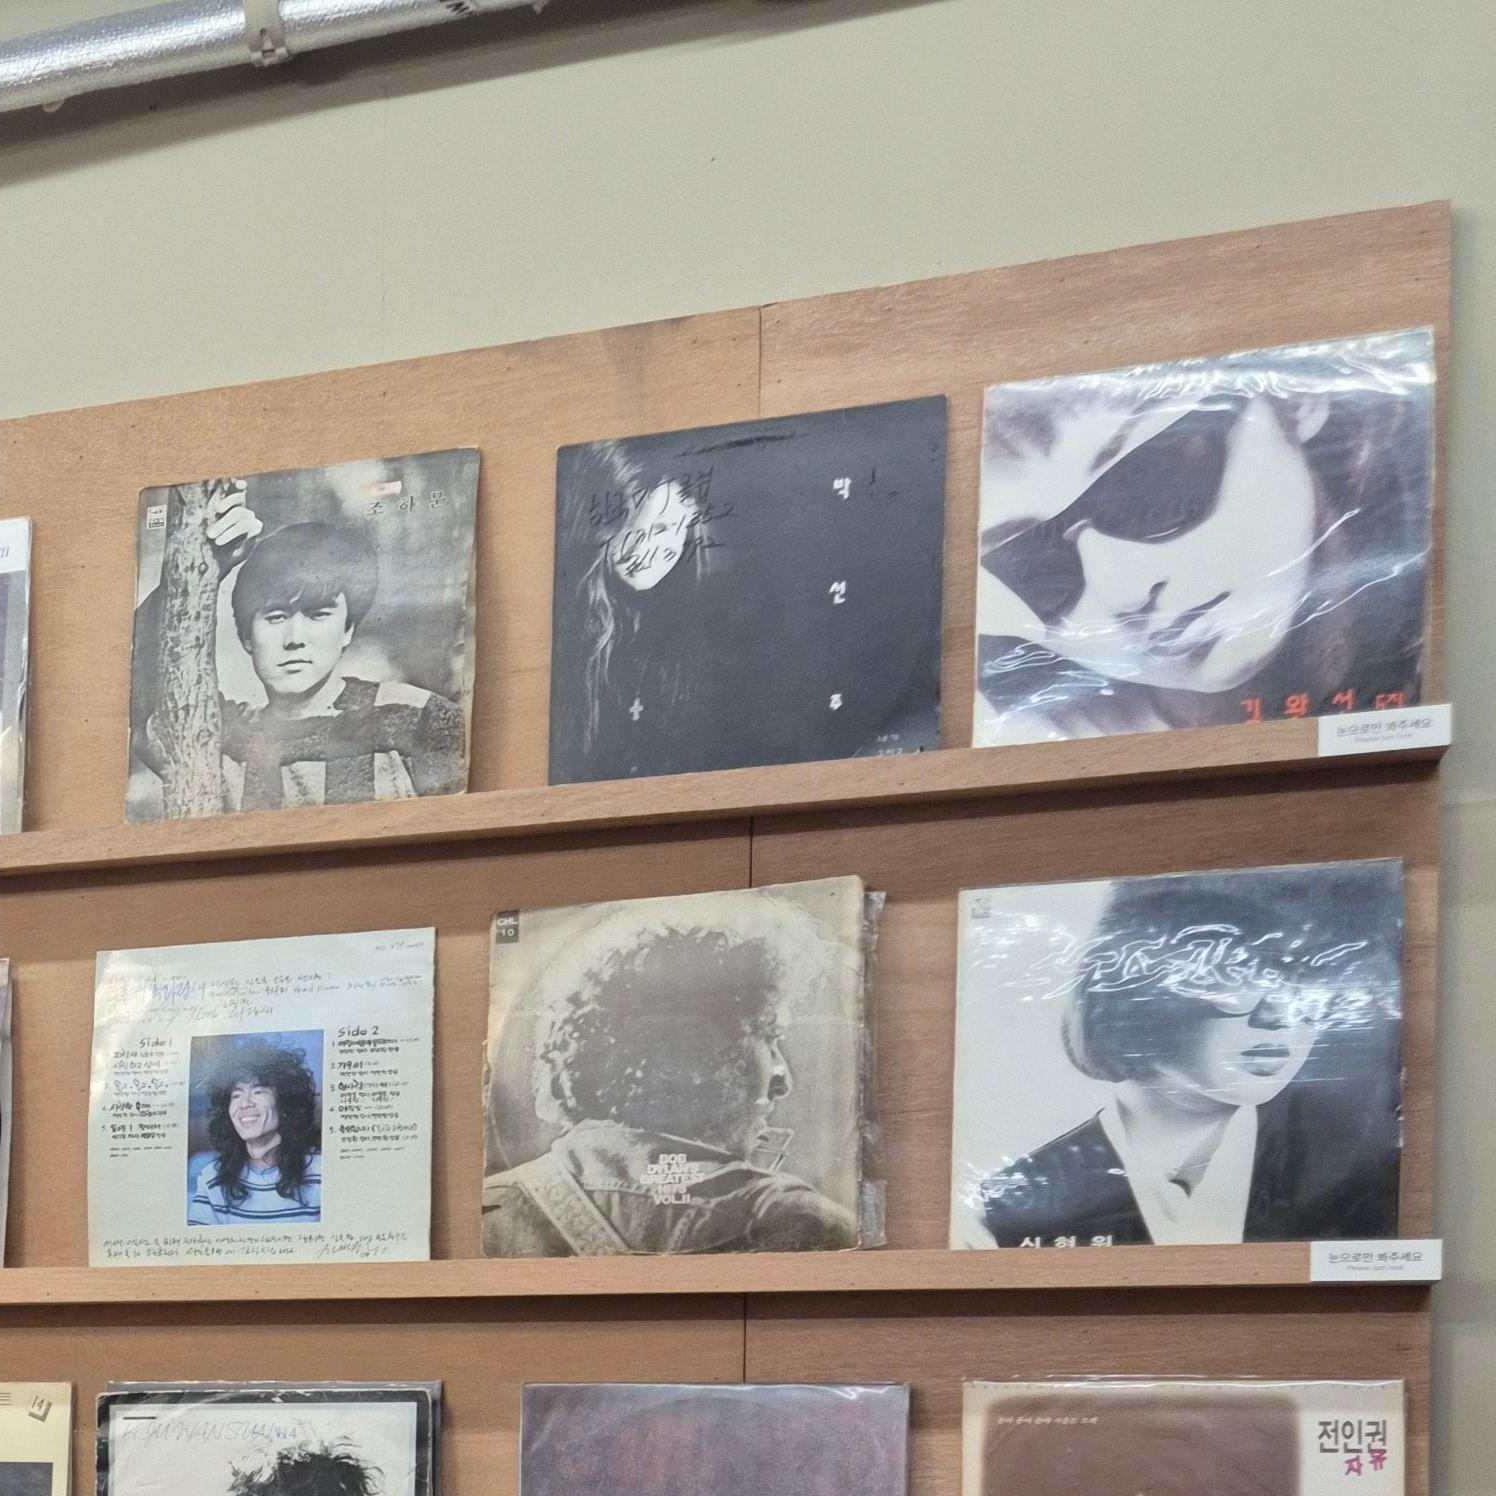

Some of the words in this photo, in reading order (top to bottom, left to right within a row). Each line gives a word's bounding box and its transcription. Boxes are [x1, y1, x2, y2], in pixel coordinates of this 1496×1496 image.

[640, 1173, 704, 1184] GREATEST
[1329, 1253, 1373, 1264] 눈으로만
[1317, 1419, 1387, 1455] 전인권
